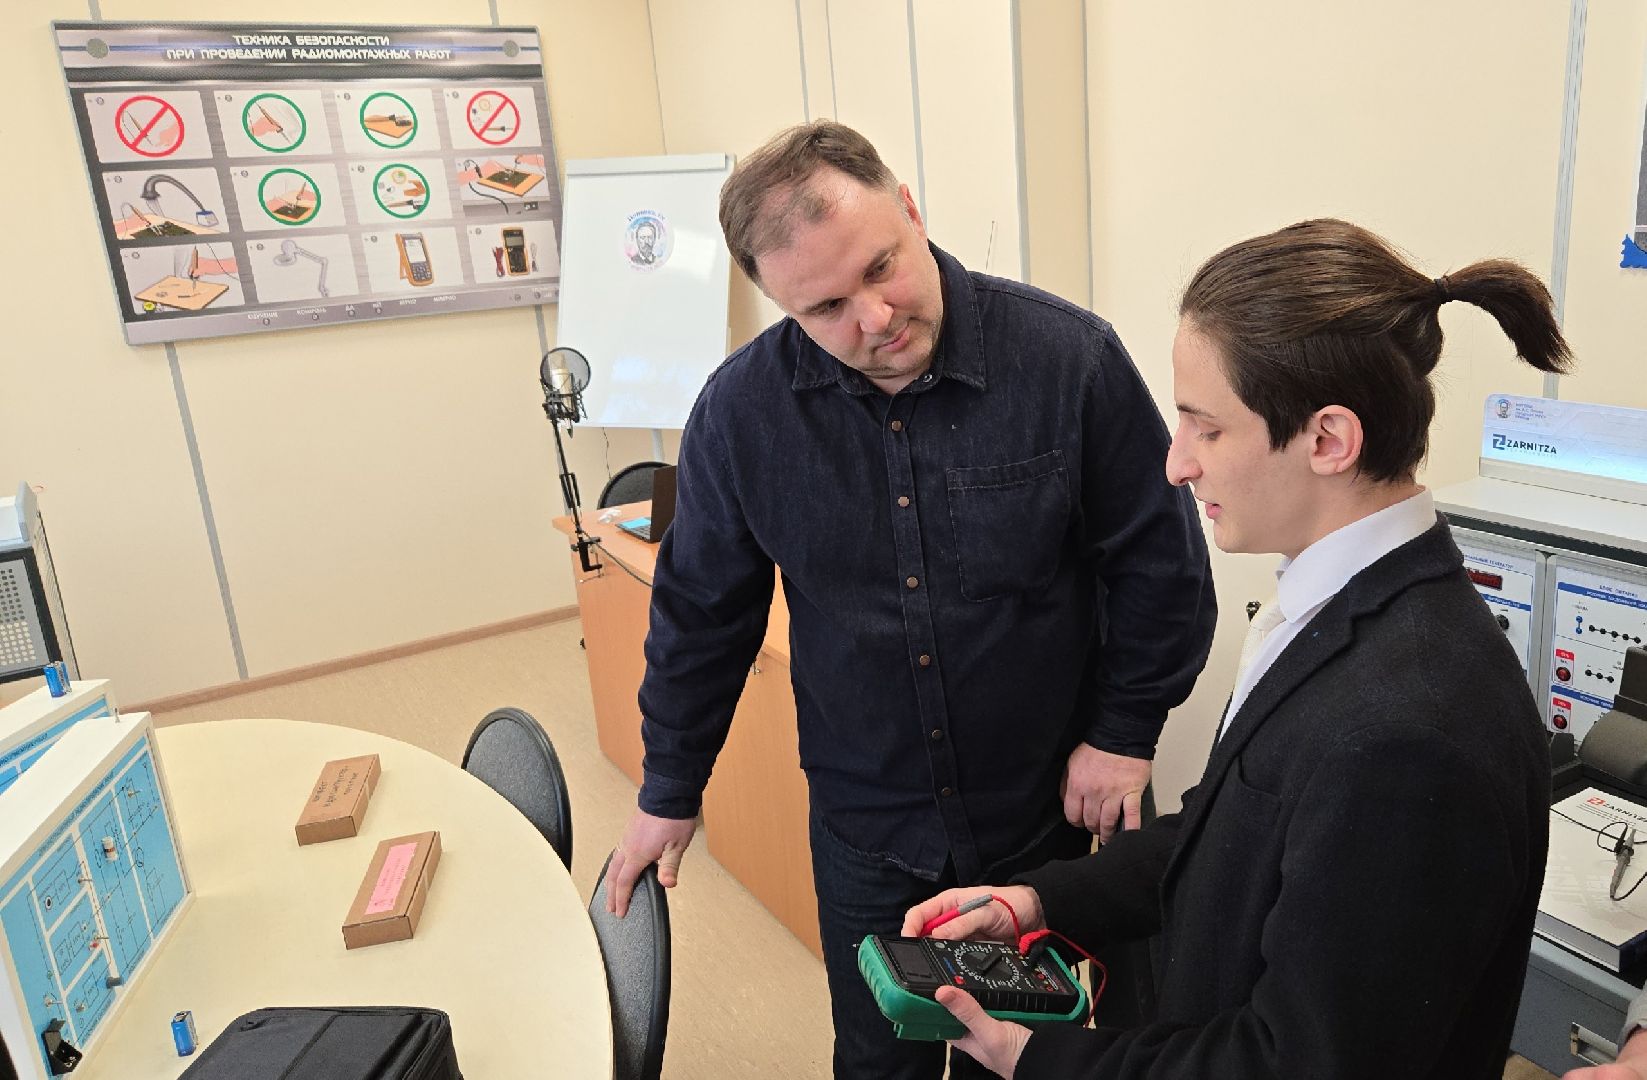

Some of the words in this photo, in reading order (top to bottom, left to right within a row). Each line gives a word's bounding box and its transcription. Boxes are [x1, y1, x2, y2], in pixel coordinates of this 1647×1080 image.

[232, 34, 292, 46] ТЕХНИКА
[295, 35, 390, 46] БЕЗОПАСНОСТИ
[166, 49, 195, 60] ПРИ
[201, 48, 287, 60] ПРОВЕДЕНИИ
[291, 49, 412, 60] РАДИОМОНТАЖНЫХ
[415, 49, 452, 60] РАБОТ
[1506, 439, 1557, 454] ZARNITZA
